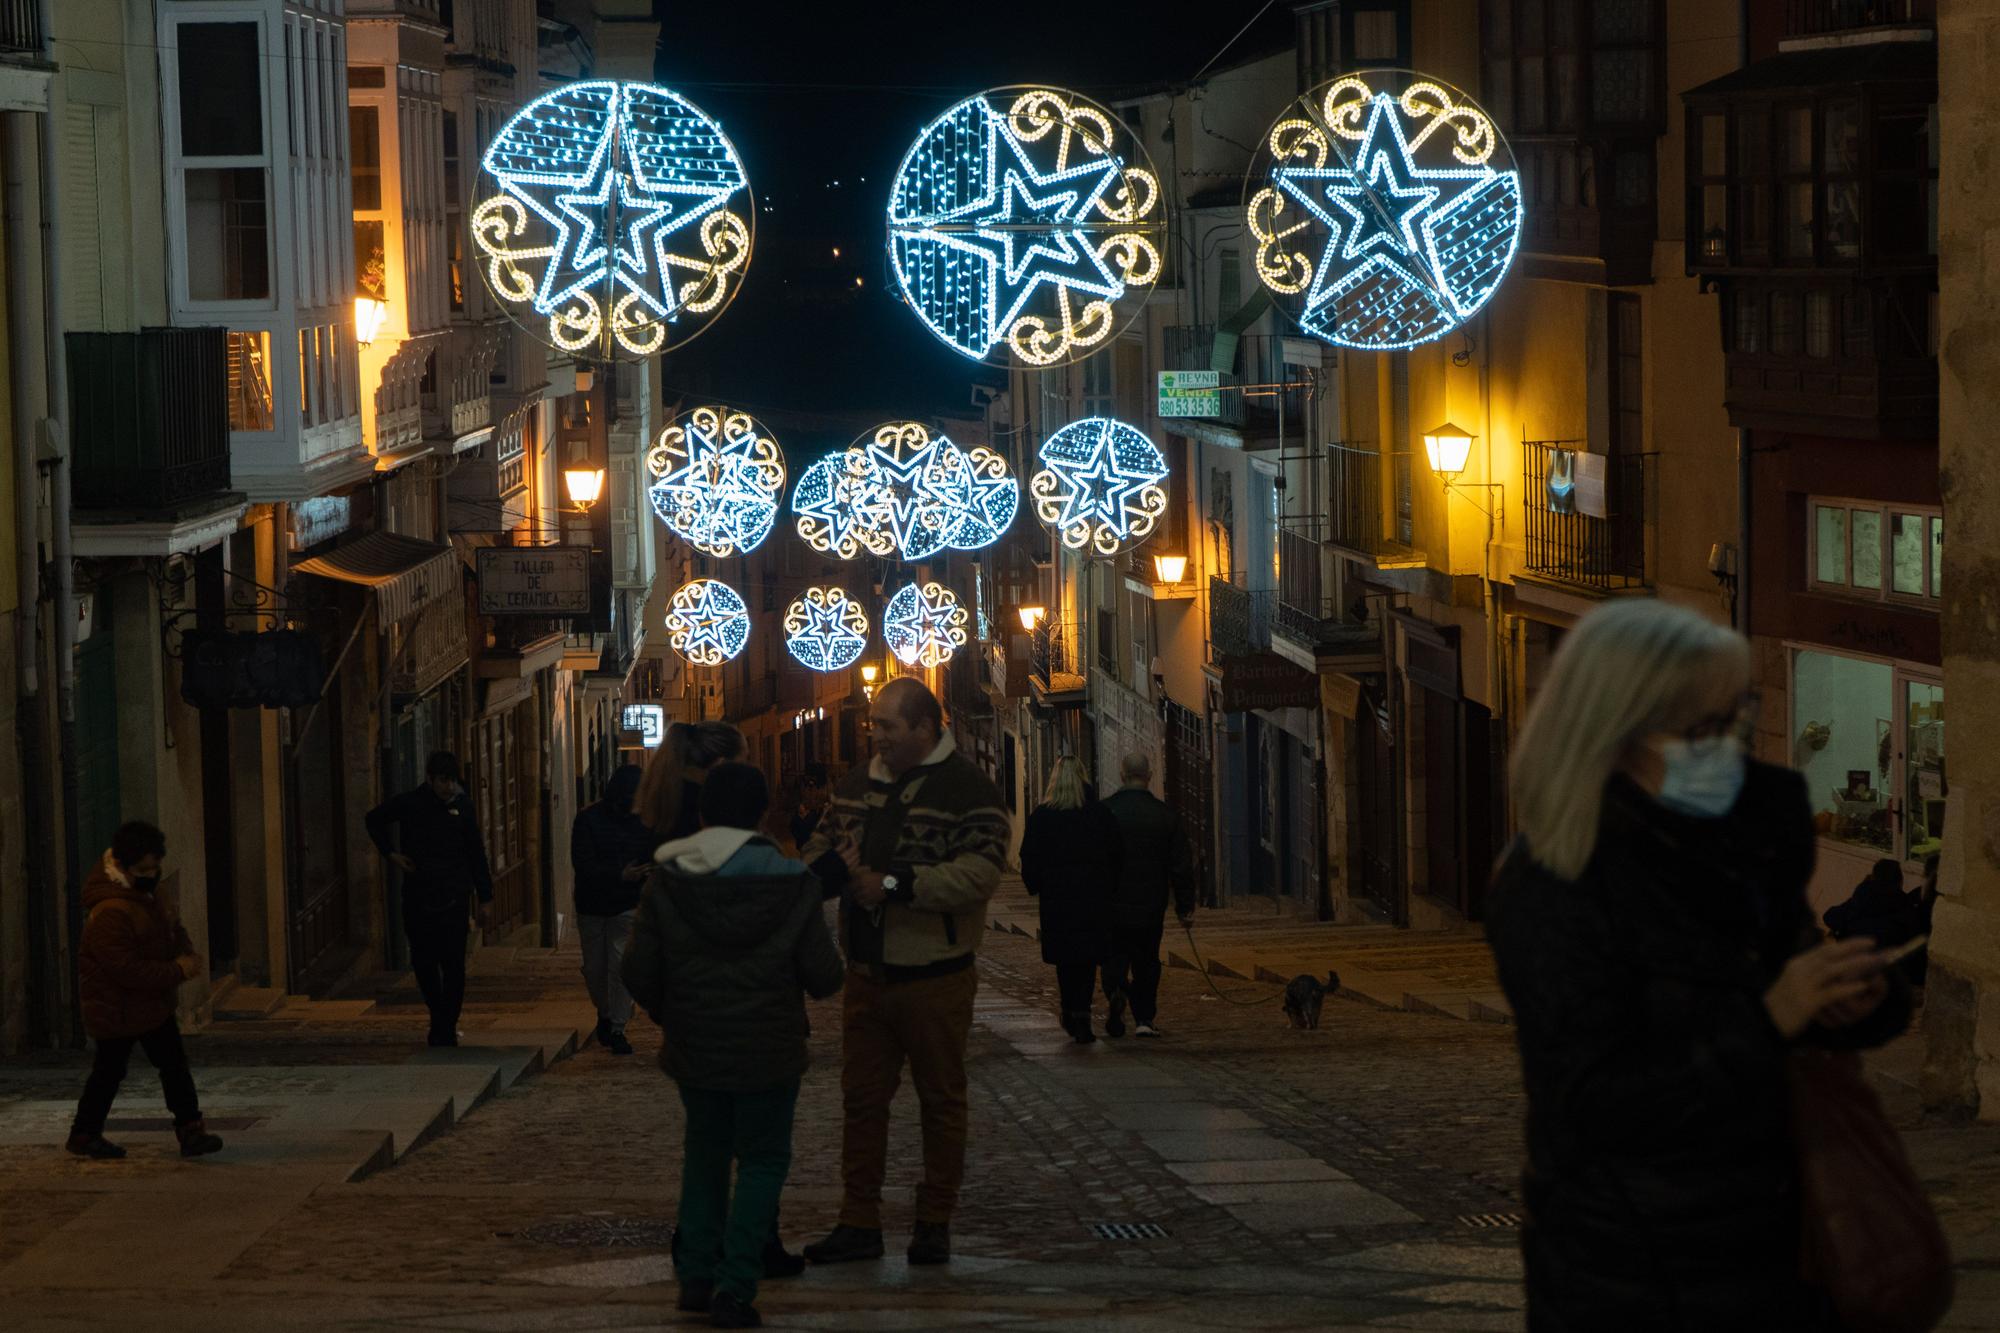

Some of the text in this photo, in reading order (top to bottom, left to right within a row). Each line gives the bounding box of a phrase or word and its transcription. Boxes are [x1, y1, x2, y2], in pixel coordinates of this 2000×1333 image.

[1178, 372, 1218, 383] REYNA
[1167, 388, 1213, 397] VENDE
[1160, 399, 1220, 415] 980 53 35 36
[513, 561, 554, 574] TALLER
[527, 576, 541, 589] DE
